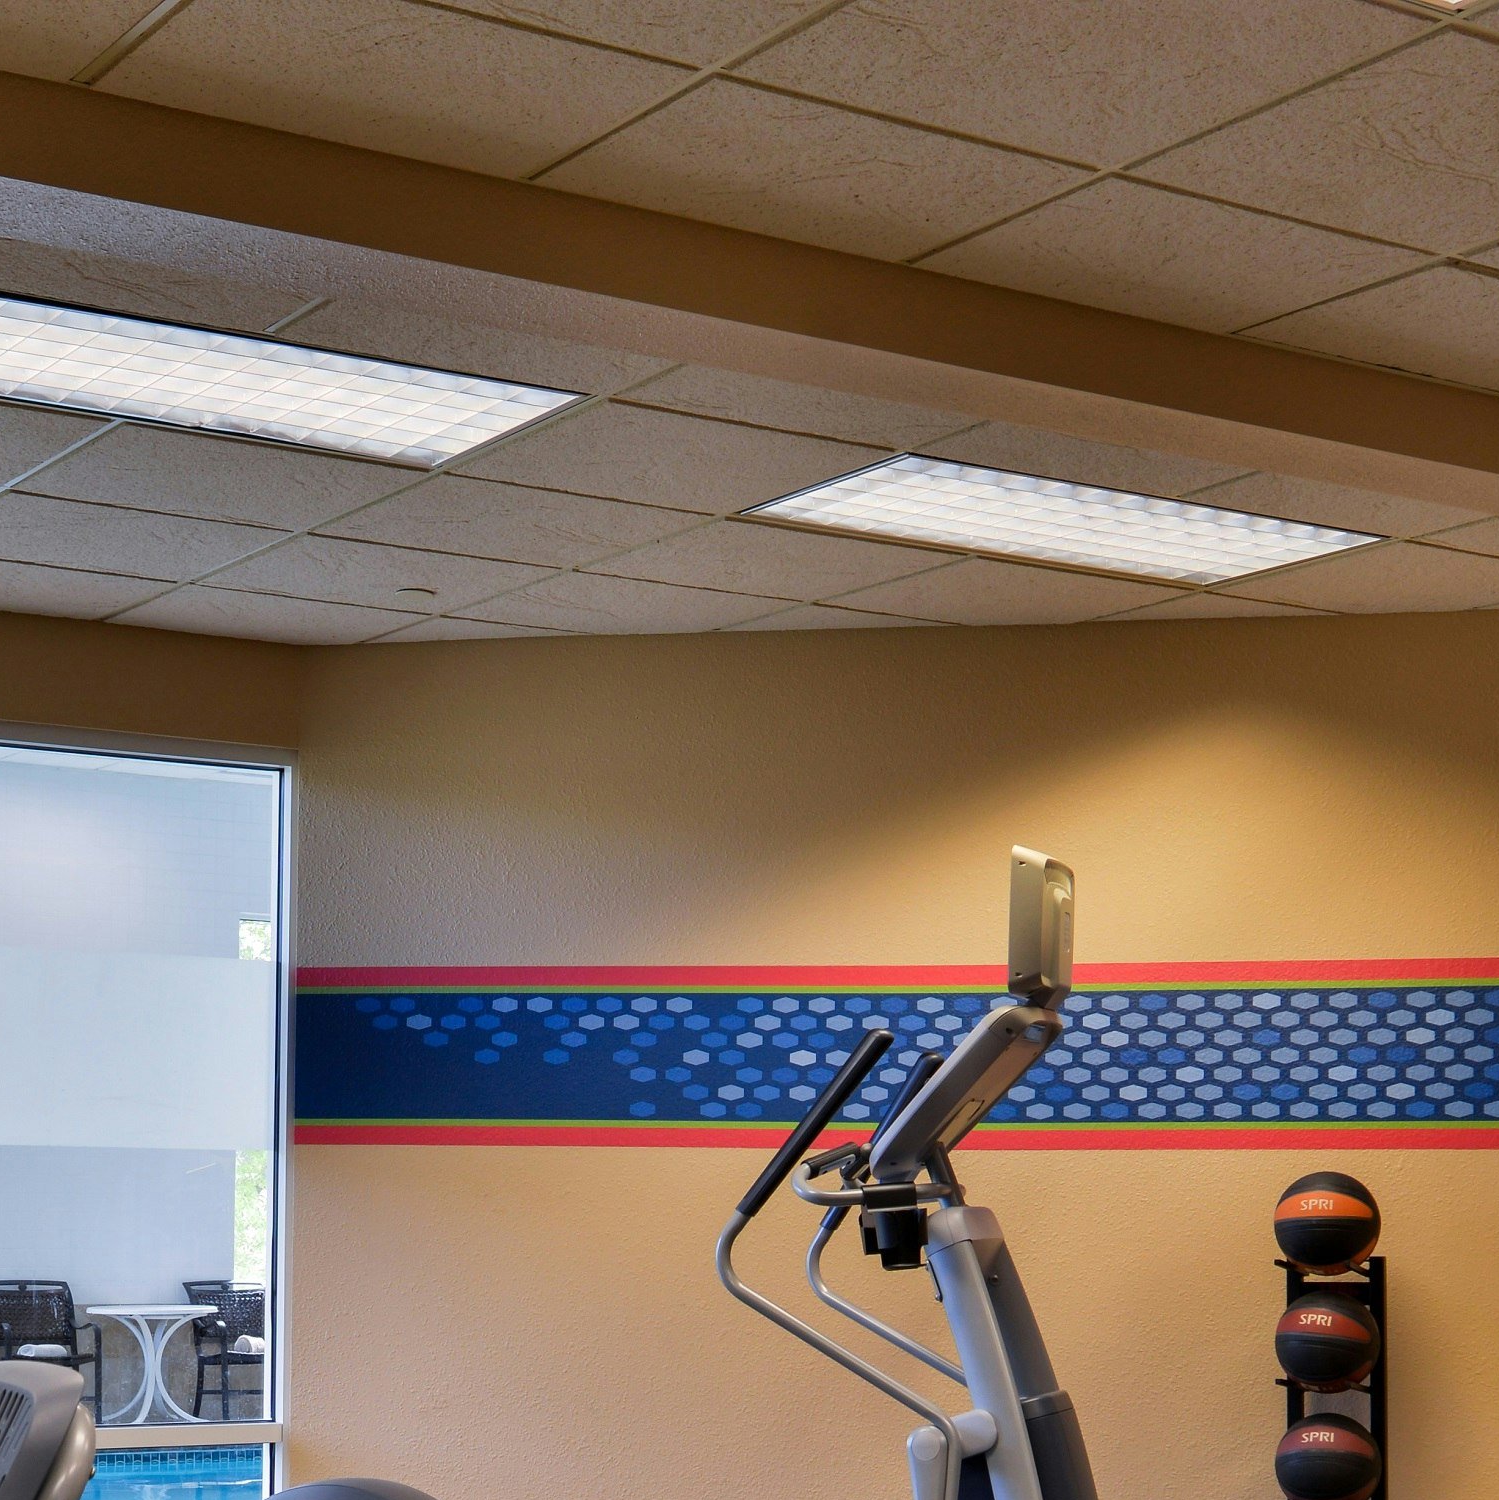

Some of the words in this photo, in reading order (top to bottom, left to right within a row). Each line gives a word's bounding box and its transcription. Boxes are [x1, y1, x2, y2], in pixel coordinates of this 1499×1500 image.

[1300, 1198, 1334, 1211] SPRI
[1299, 1313, 1332, 1327] SPRI
[1301, 1431, 1335, 1443] SPRI
